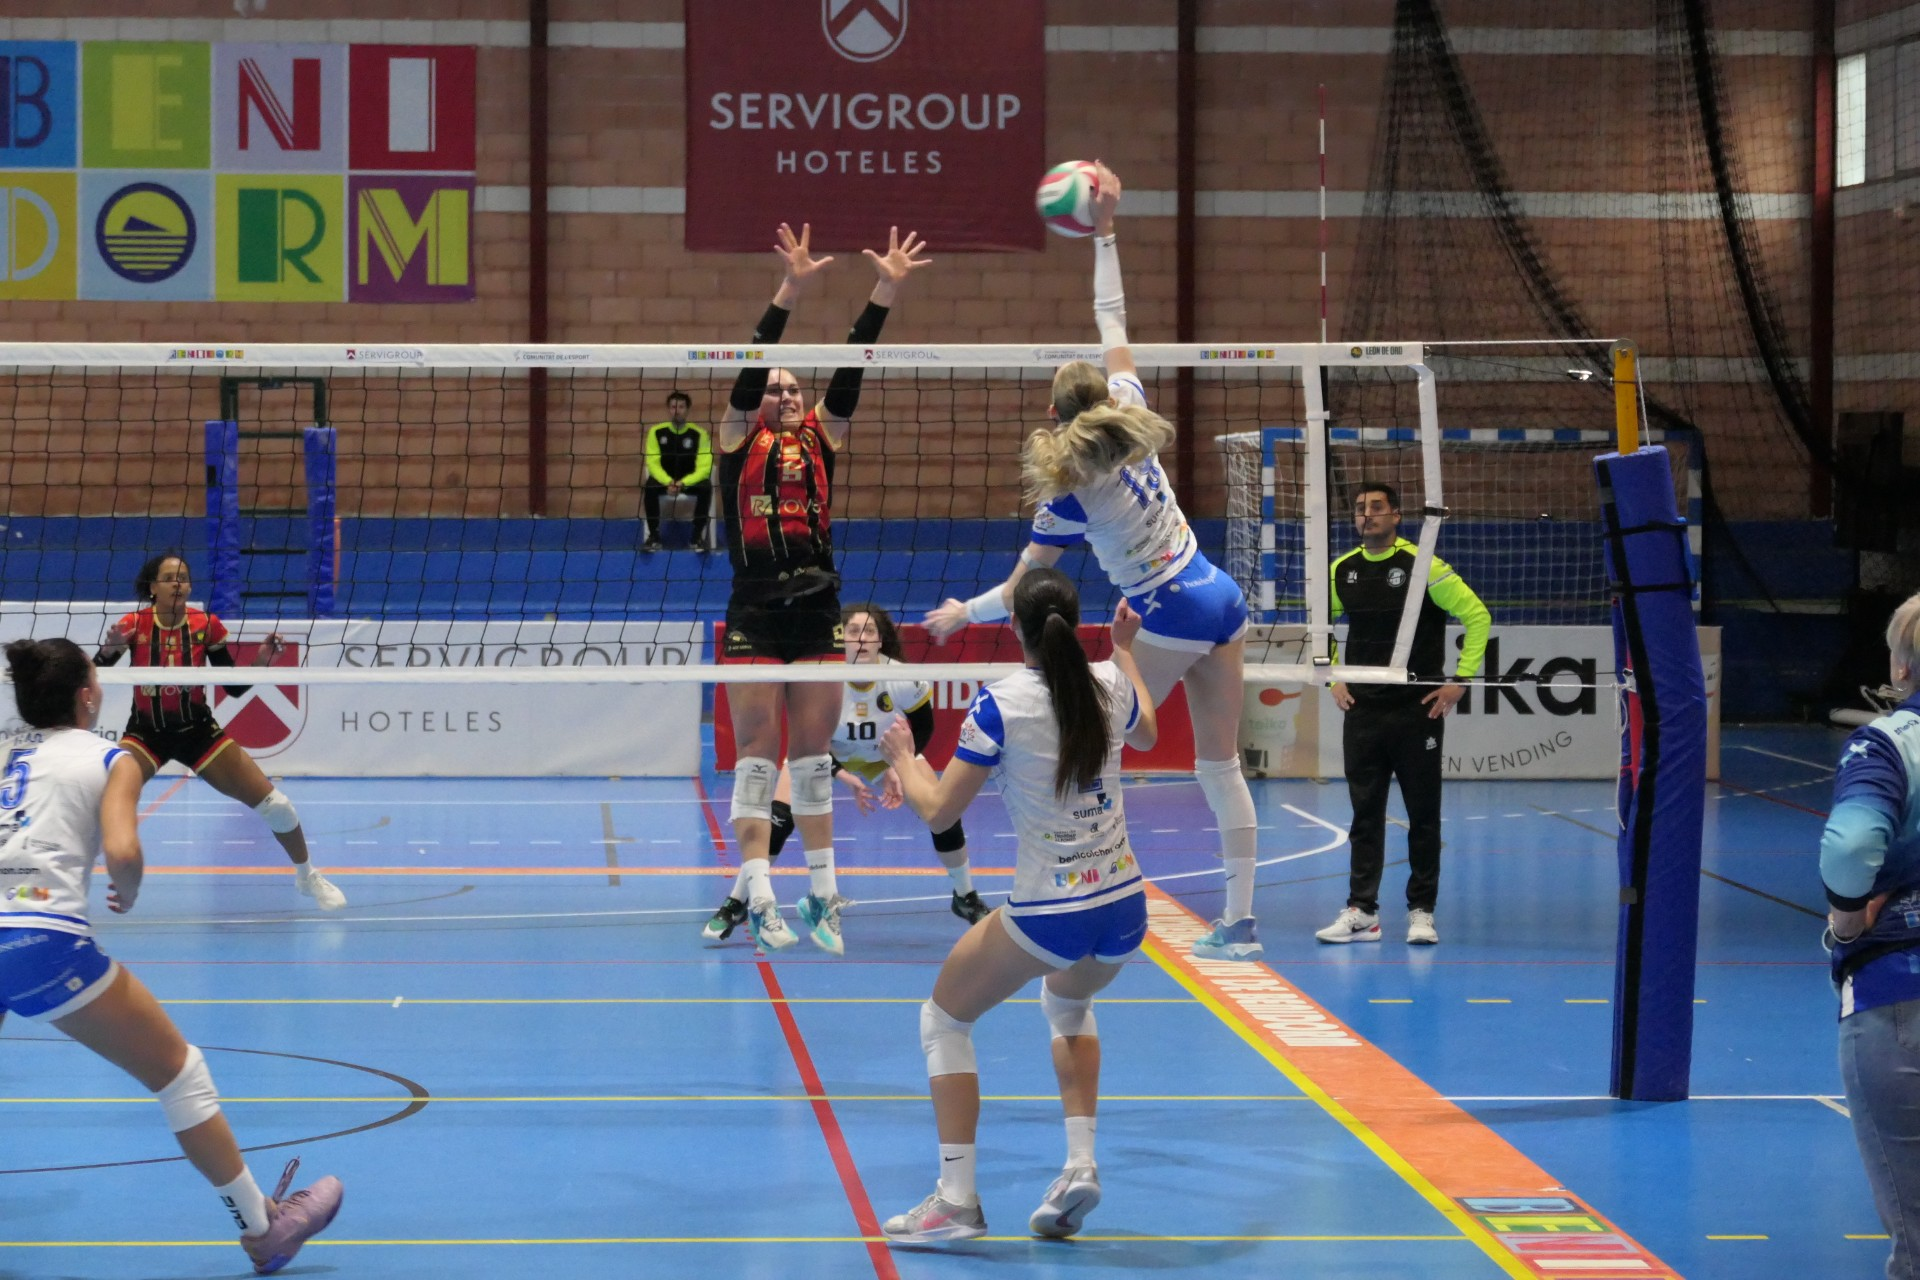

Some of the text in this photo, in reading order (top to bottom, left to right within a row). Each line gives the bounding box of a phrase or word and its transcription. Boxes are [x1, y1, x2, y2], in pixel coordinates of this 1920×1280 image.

[709, 92, 1022, 131] SERVIGROUP
[776, 150, 943, 175] HOTELES
[1455, 633, 1597, 716] ika
[341, 710, 502, 733] HOTELES
[846, 721, 877, 741] 10
[1472, 730, 1573, 774] VENDING
[1073, 805, 1104, 820] suma
[1227, 993, 1364, 1047] BENIDORM
